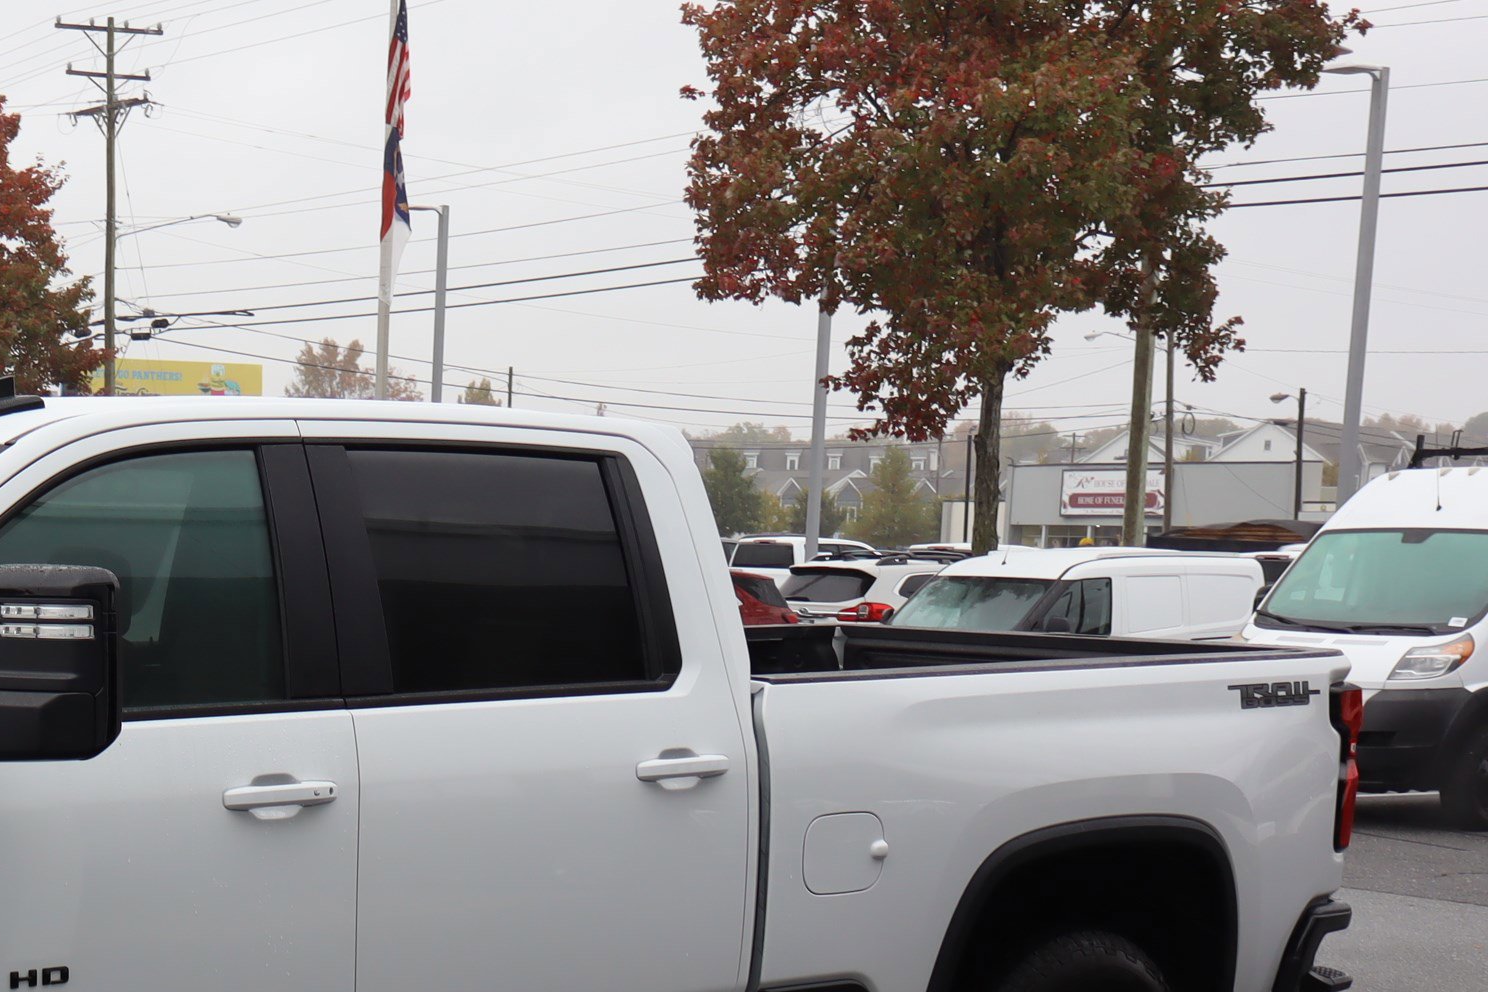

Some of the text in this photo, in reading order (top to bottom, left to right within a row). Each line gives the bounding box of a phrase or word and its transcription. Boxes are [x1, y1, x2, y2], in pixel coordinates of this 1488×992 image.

[132, 370, 182, 381] PANTHERS!
[1241, 696, 1310, 709] BOSS
[9, 965, 70, 990] HD
